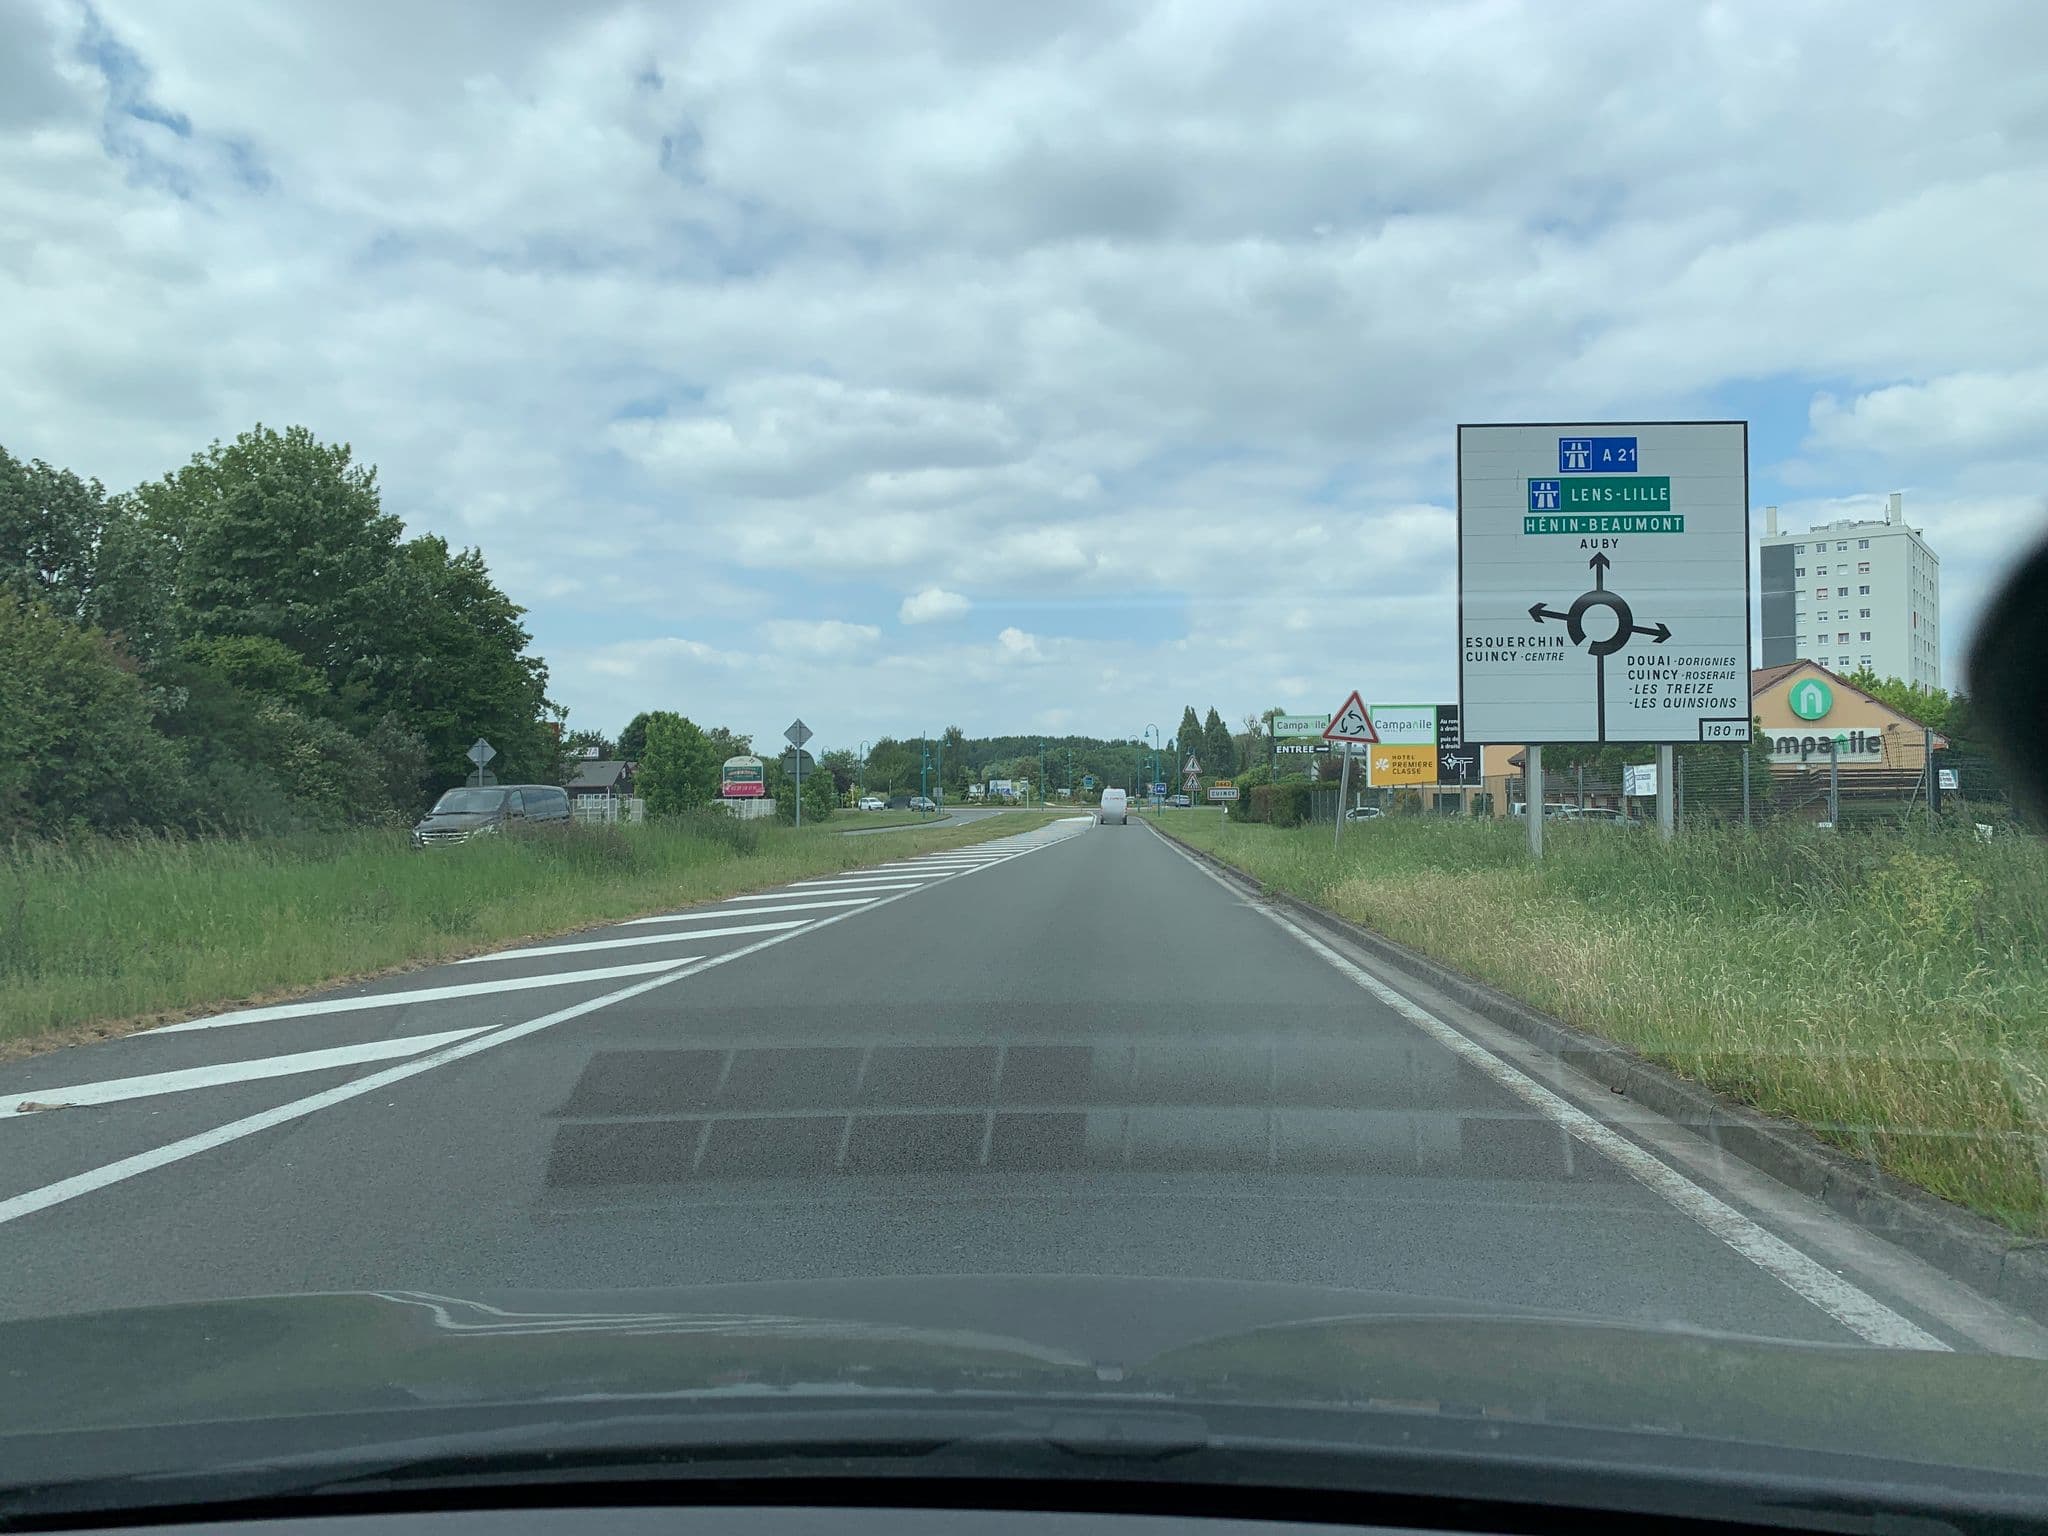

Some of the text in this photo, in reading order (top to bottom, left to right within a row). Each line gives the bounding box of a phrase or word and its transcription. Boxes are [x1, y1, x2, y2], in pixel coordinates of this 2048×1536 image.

[1602, 448, 1637, 461] A 21
[1571, 487, 1668, 502] LENS-LILLE
[1526, 516, 1682, 532] HÉNIN-BEAUMONT
[1580, 538, 1619, 549] AUBY
[1466, 636, 1565, 648] ESQUERCHIN
[1466, 651, 1517, 662] CUINCY
[1627, 655, 1671, 667] DOUAI
[1627, 669, 1679, 680] CUINCY
[1667, 683, 1714, 694] TREIZE
[1662, 697, 1737, 709] QUINSIONS
[1277, 720, 1326, 732] Campaile
[1374, 720, 1432, 732] Campanile
[1707, 725, 1745, 737] 180 m
[1276, 746, 1314, 754] ENTREE
[1763, 730, 1881, 761] ampanile
